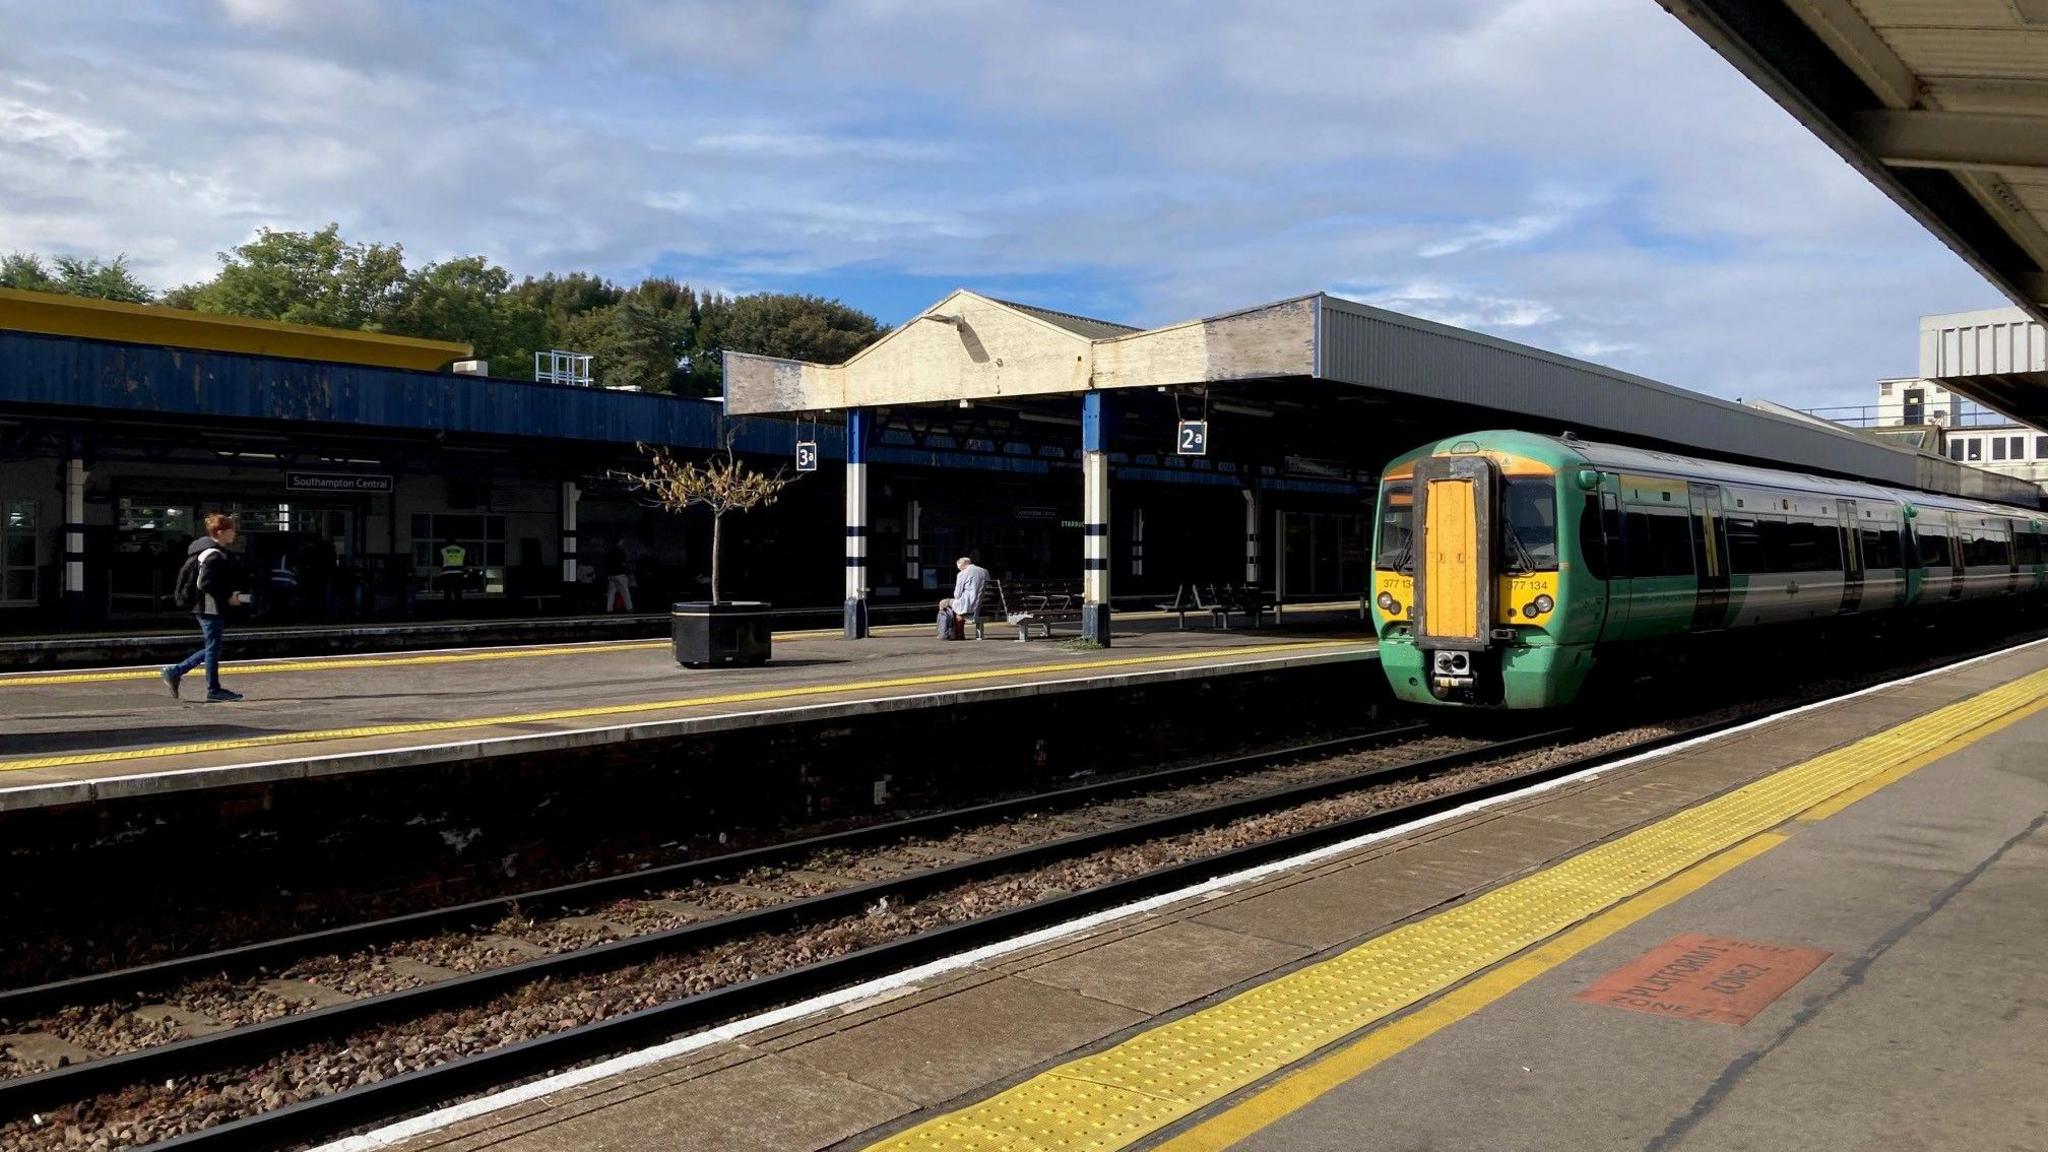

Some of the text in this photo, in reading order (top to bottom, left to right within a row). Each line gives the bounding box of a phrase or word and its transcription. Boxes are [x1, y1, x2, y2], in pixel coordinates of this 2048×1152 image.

[1182, 429, 1203, 448] 2a
[799, 449, 814, 465] 3a
[293, 476, 387, 488] Southampton Central
[1061, 520, 1085, 528] STARBUC
[1383, 579, 1400, 588] 377
[1506, 580, 1548, 590] 377 134
[1624, 950, 1720, 998] PLATFORM
